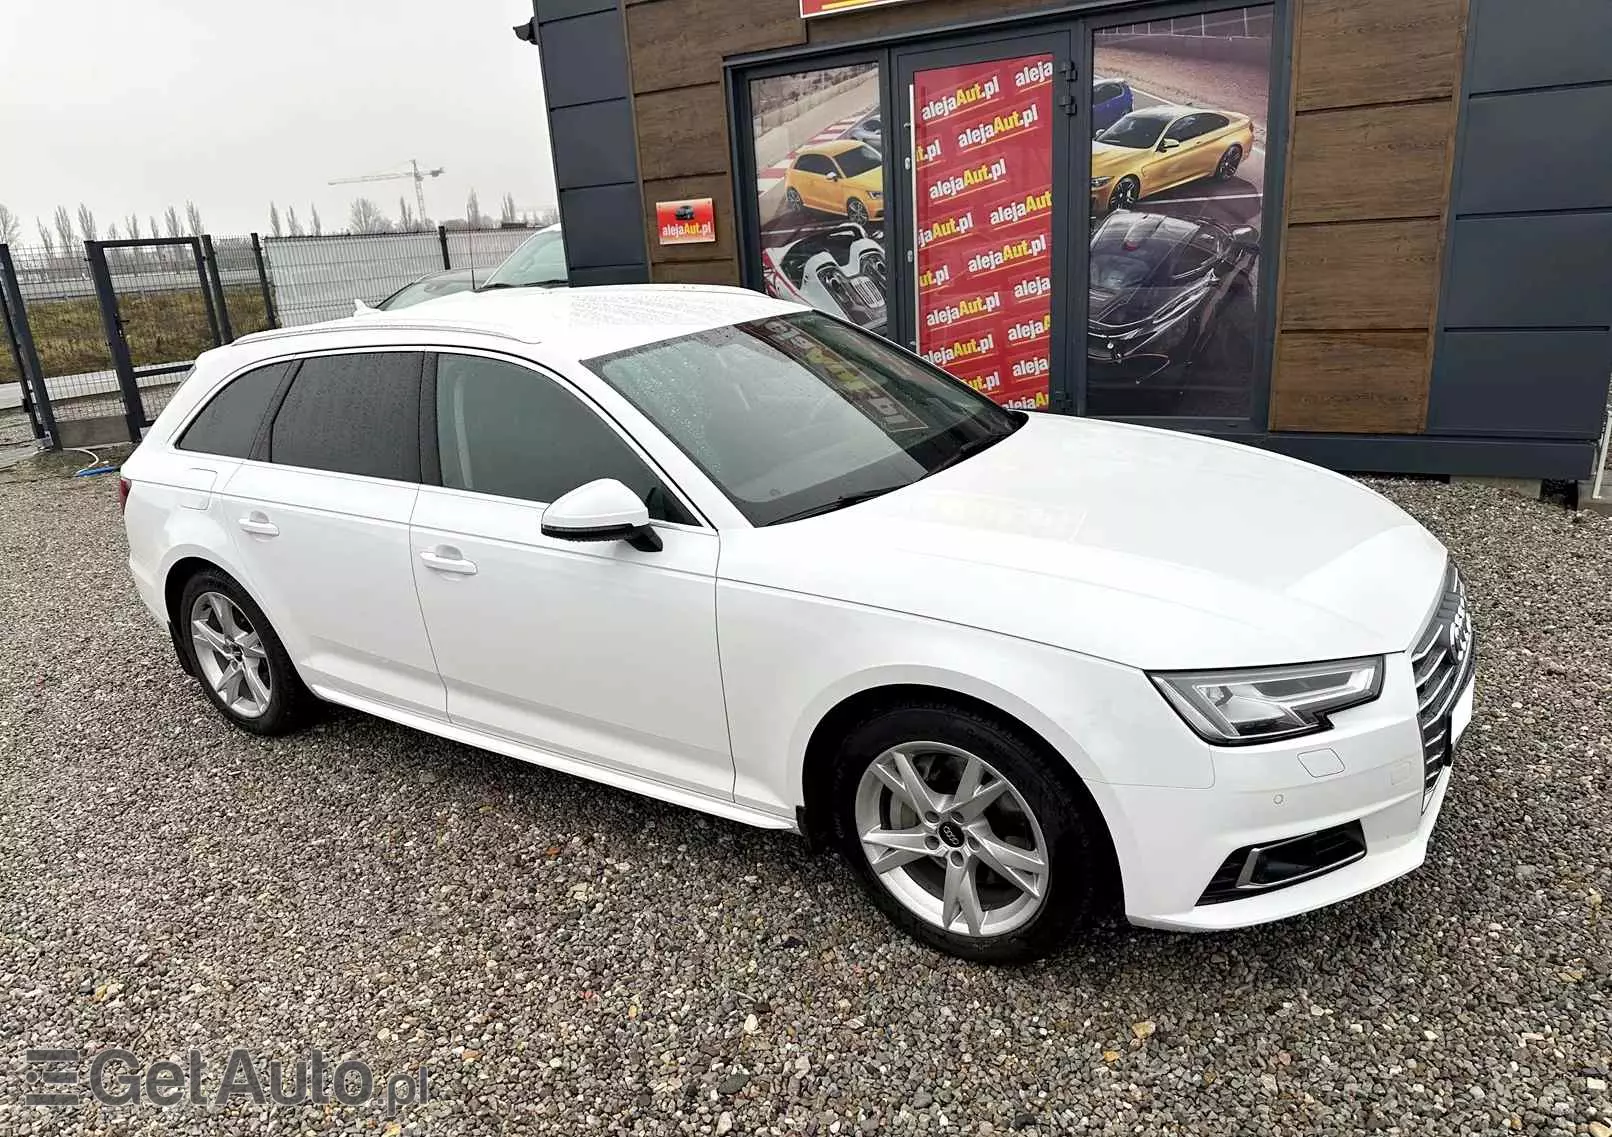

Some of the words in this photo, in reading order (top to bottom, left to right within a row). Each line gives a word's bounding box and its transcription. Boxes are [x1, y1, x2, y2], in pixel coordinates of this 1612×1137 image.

[921, 76, 999, 120] alejaAut.pl
[958, 104, 1038, 148] alejaAut.pl
[929, 158, 1006, 199] alejaAut.pl
[662, 221, 712, 238] alejaAut.pl
[918, 212, 973, 247] jaAut.pl
[968, 235, 1046, 272] alejaAut.pl
[927, 292, 1000, 326] alejaAut.pl
[962, 372, 999, 390] ut.pl
